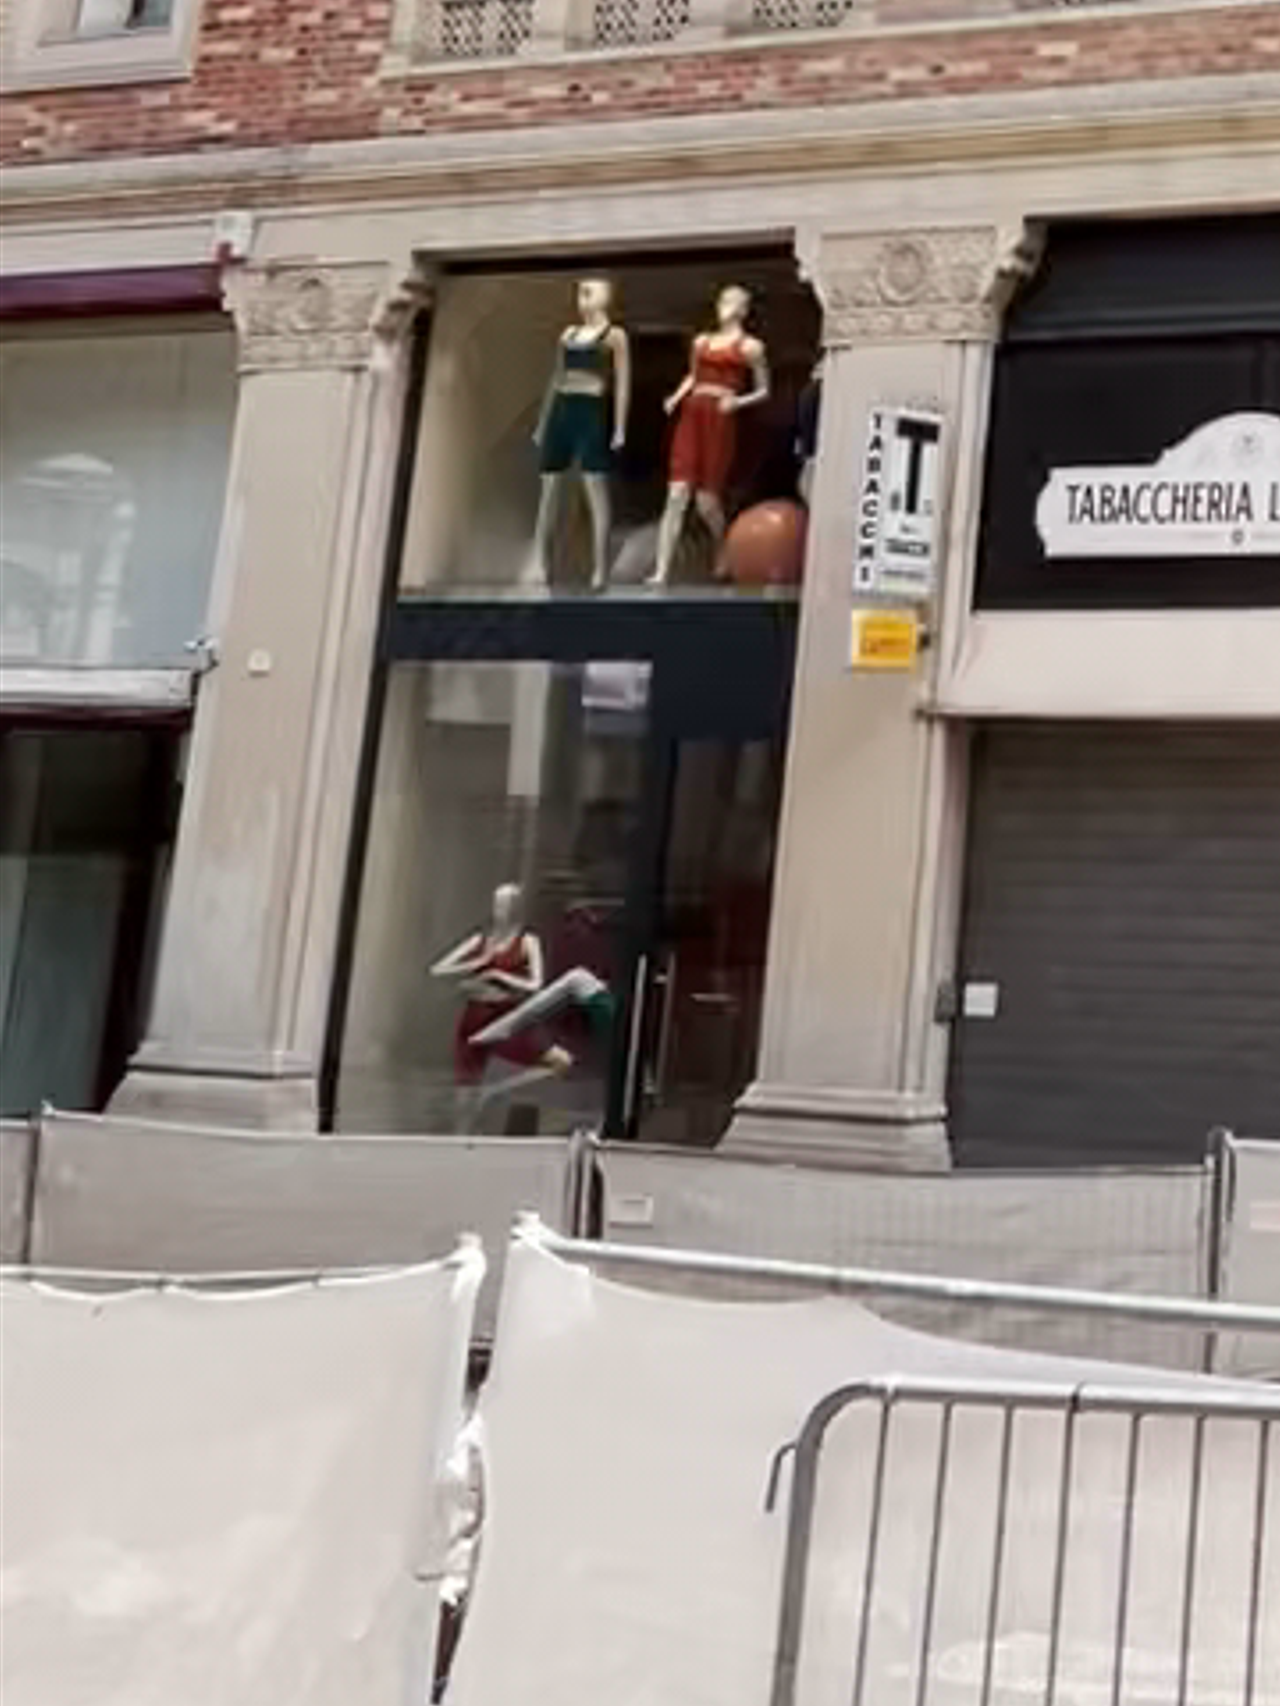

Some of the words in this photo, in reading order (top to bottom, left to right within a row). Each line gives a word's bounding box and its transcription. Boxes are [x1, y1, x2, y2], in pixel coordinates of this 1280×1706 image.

[858, 413, 882, 582] TABACCHI
[895, 415, 941, 515] T
[1066, 481, 1253, 525] TABACCHERIA
